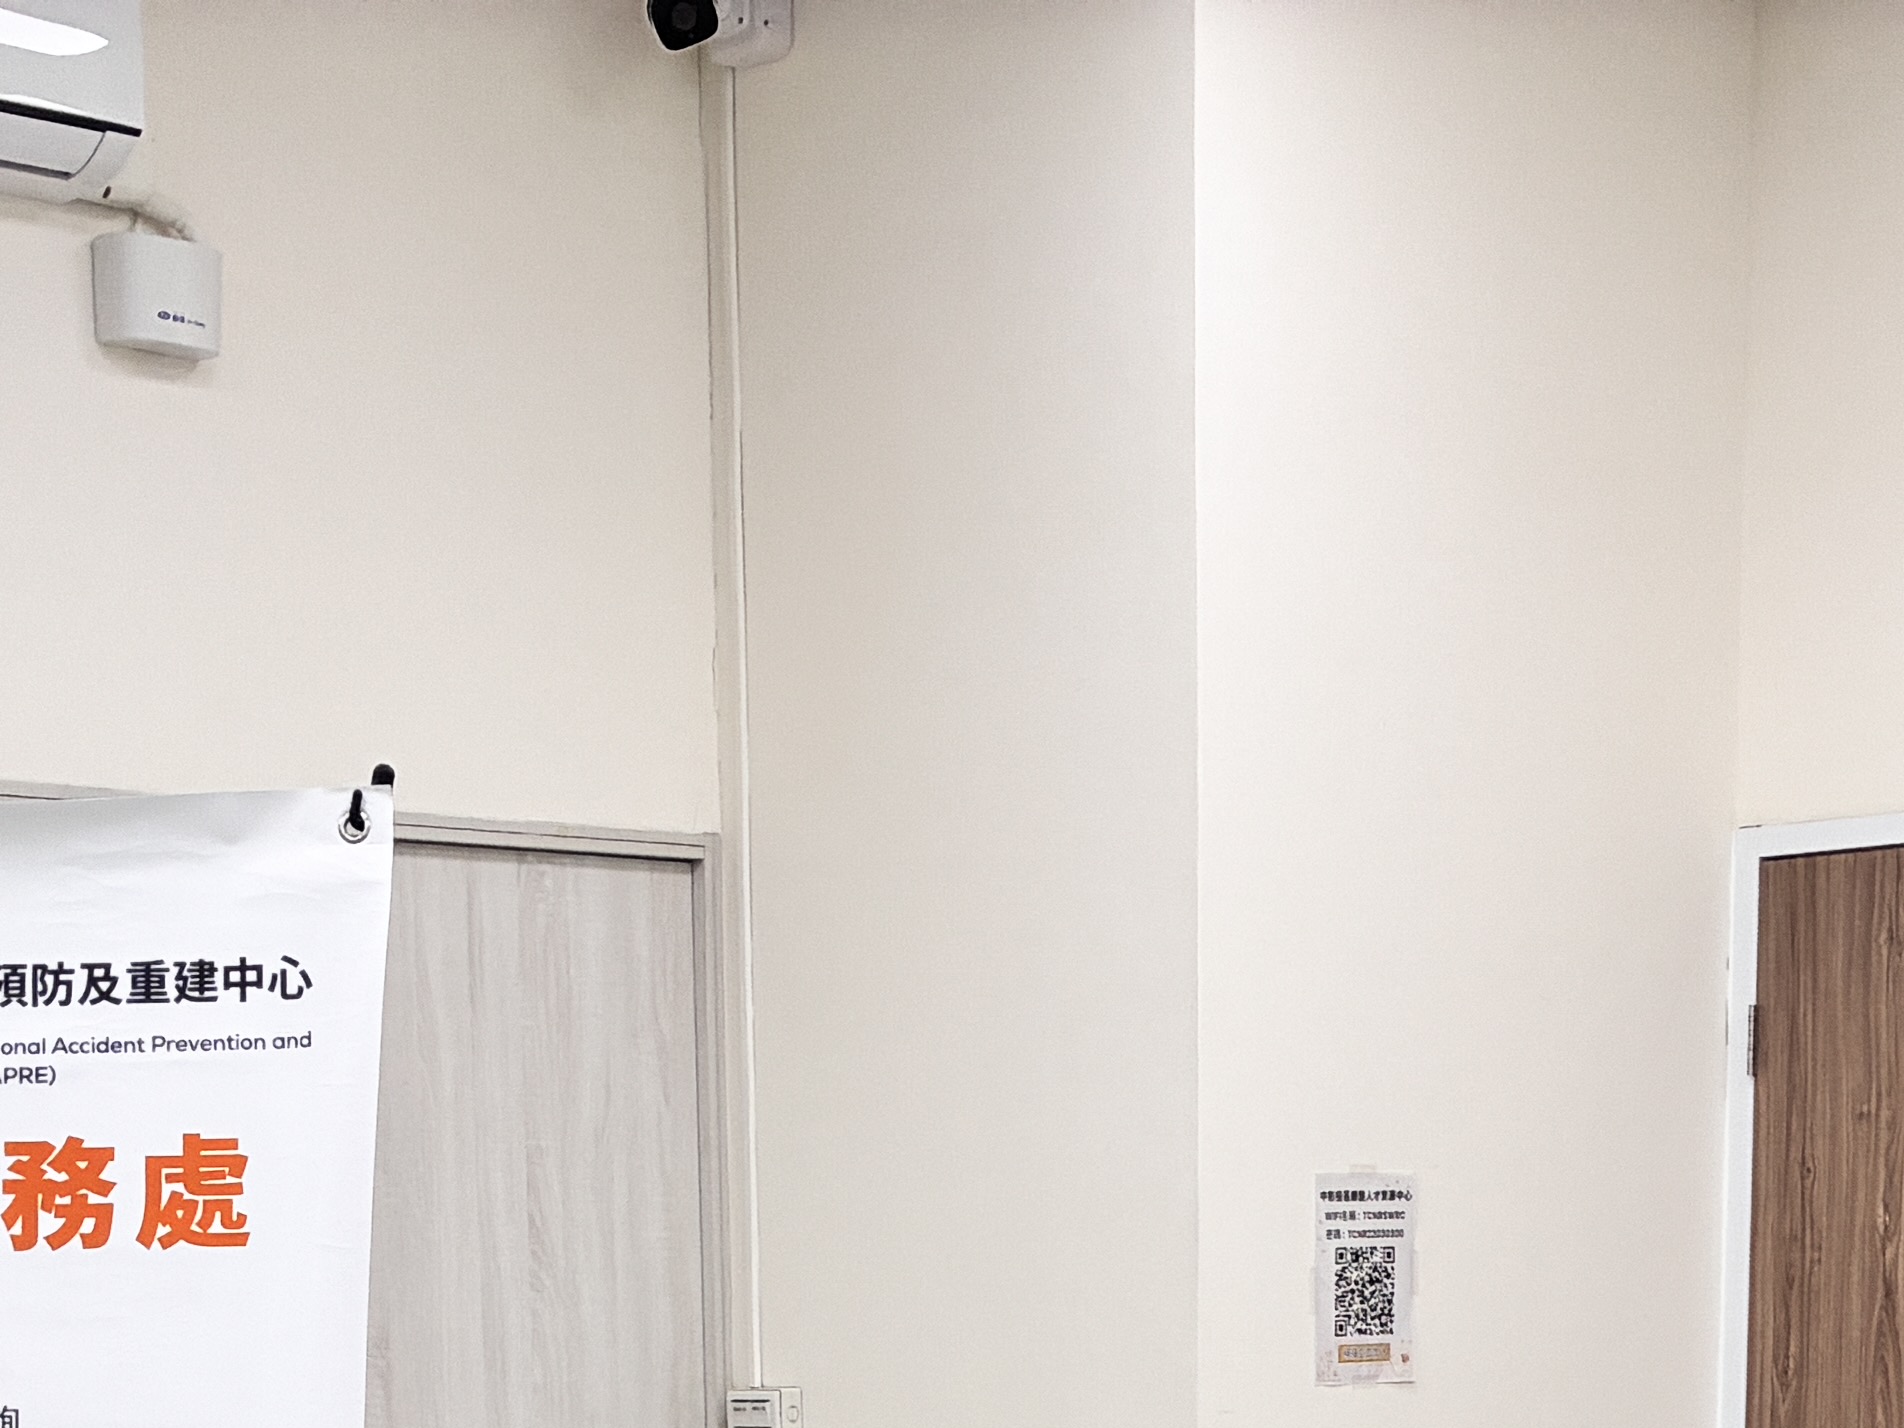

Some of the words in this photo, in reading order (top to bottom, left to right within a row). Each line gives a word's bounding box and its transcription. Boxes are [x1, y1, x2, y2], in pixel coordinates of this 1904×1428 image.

[52, 1033, 147, 1058] Accident
[151, 1031, 267, 1056] Prevention
[272, 1029, 313, 1053] and
